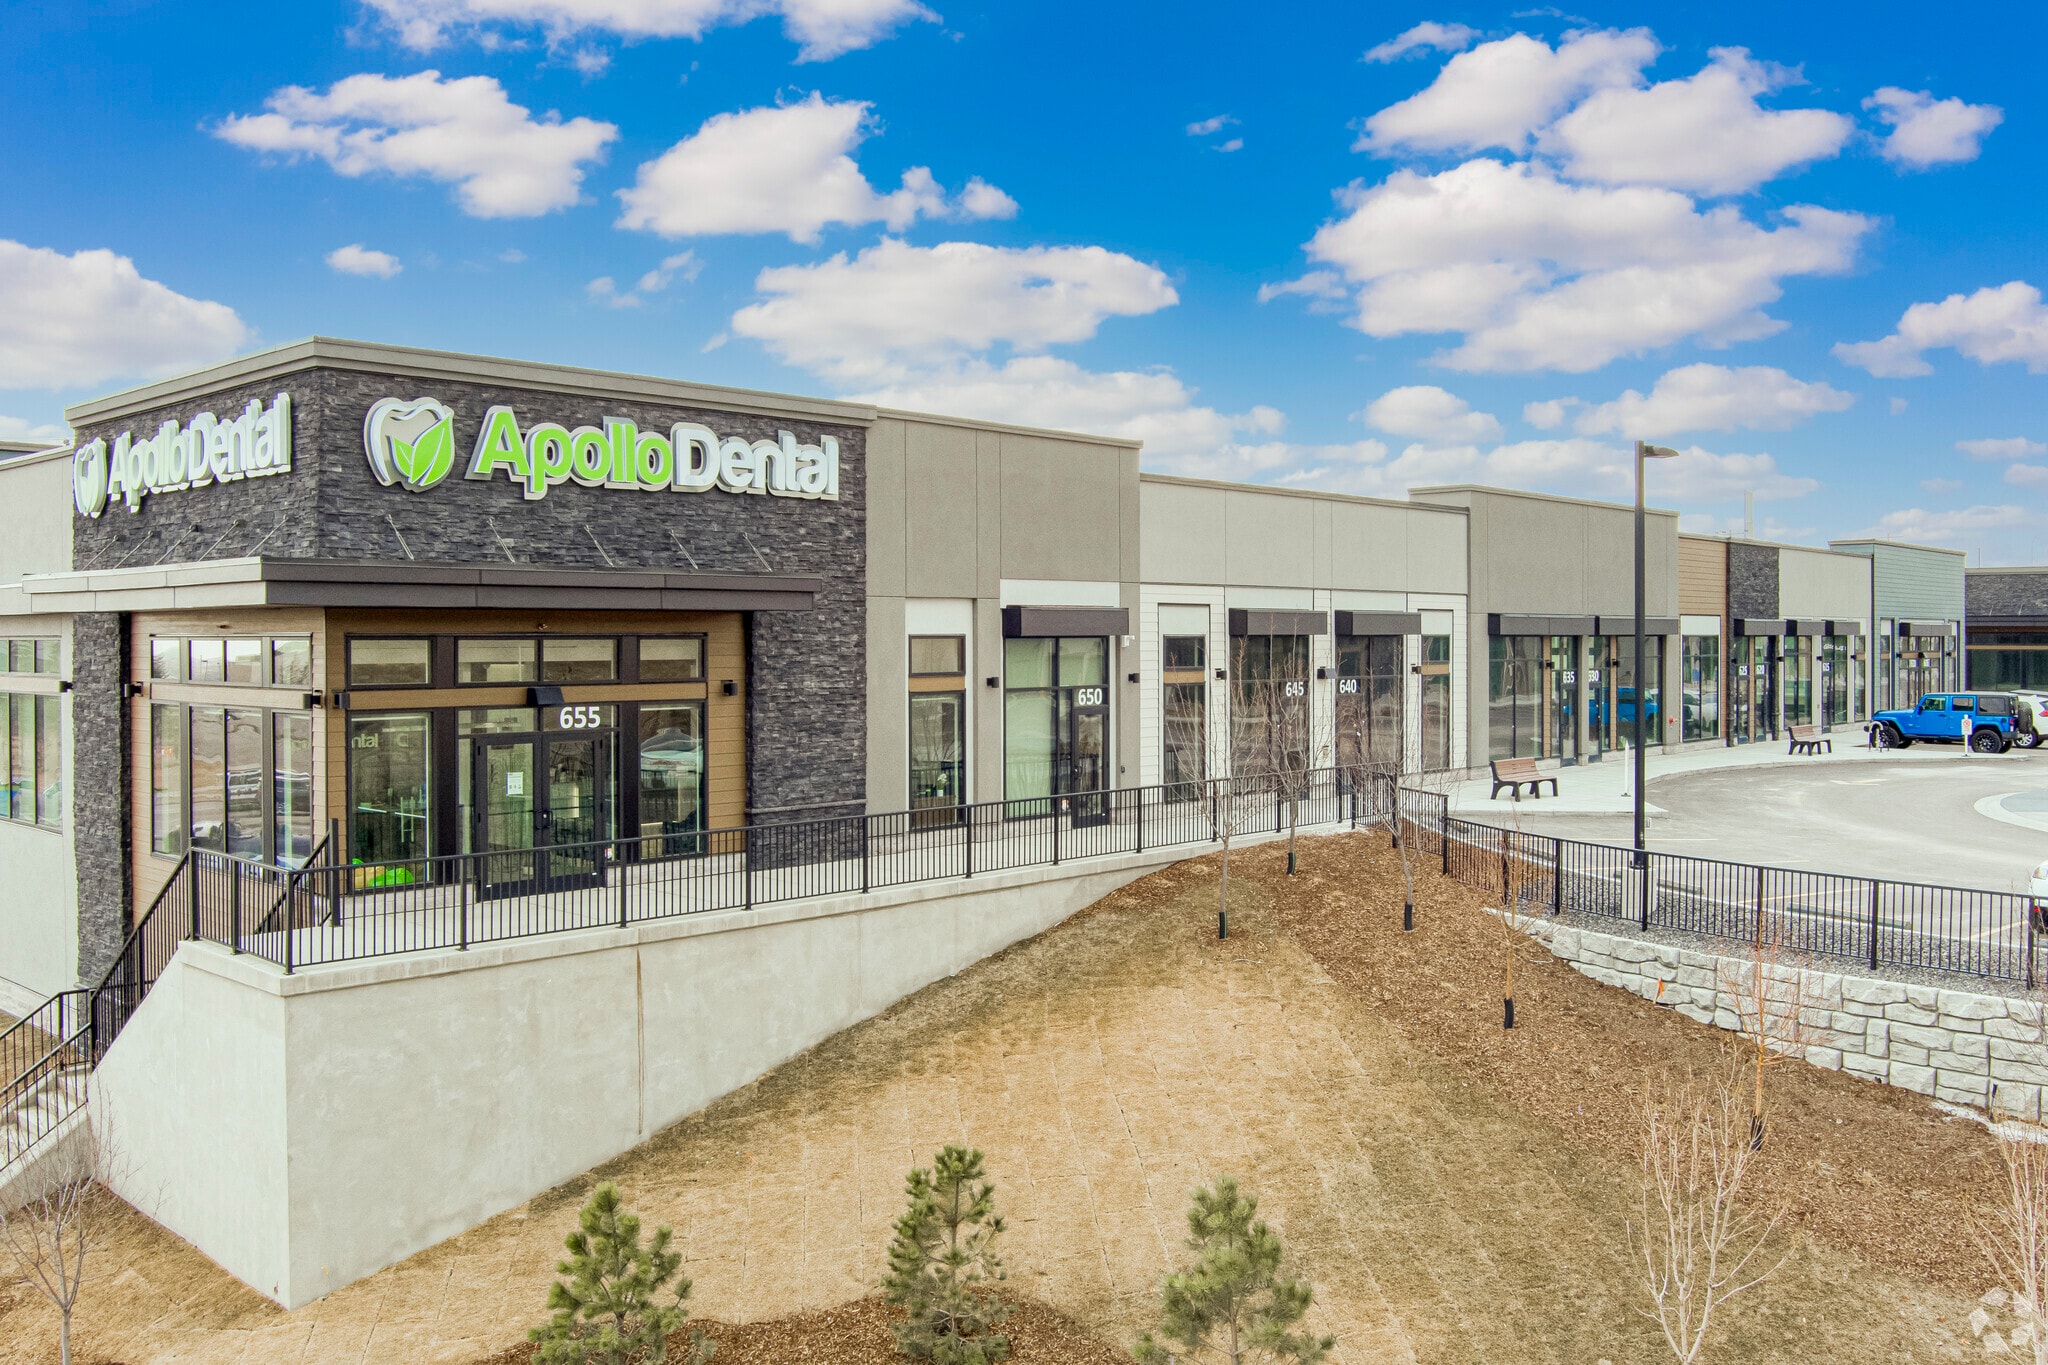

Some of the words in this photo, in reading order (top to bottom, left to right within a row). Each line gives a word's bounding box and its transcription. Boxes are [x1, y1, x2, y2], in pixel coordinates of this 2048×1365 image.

[1285, 681, 1304, 697] 645
[1339, 679, 1357, 694] 640
[1078, 688, 1103, 705] 650
[560, 706, 601, 729] 655
